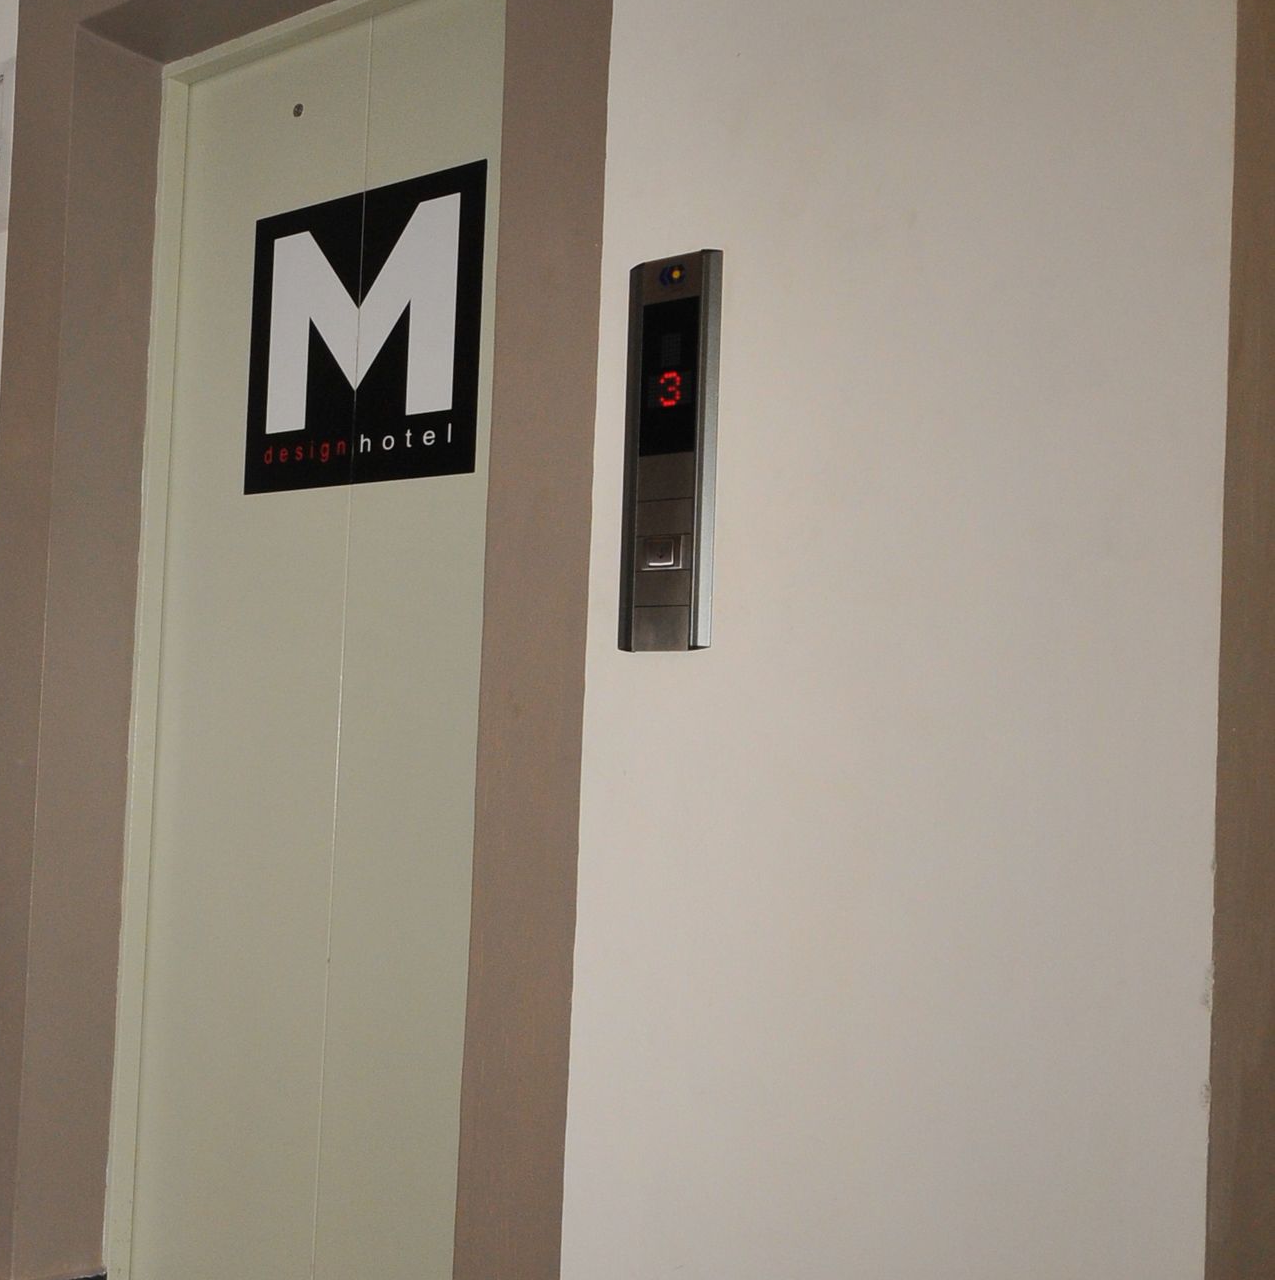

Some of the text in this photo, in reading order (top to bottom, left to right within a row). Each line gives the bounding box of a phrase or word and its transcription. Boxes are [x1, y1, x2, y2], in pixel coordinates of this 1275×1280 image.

[265, 192, 461, 434] M
[660, 371, 681, 407] 3
[264, 423, 452, 463] design hotel
